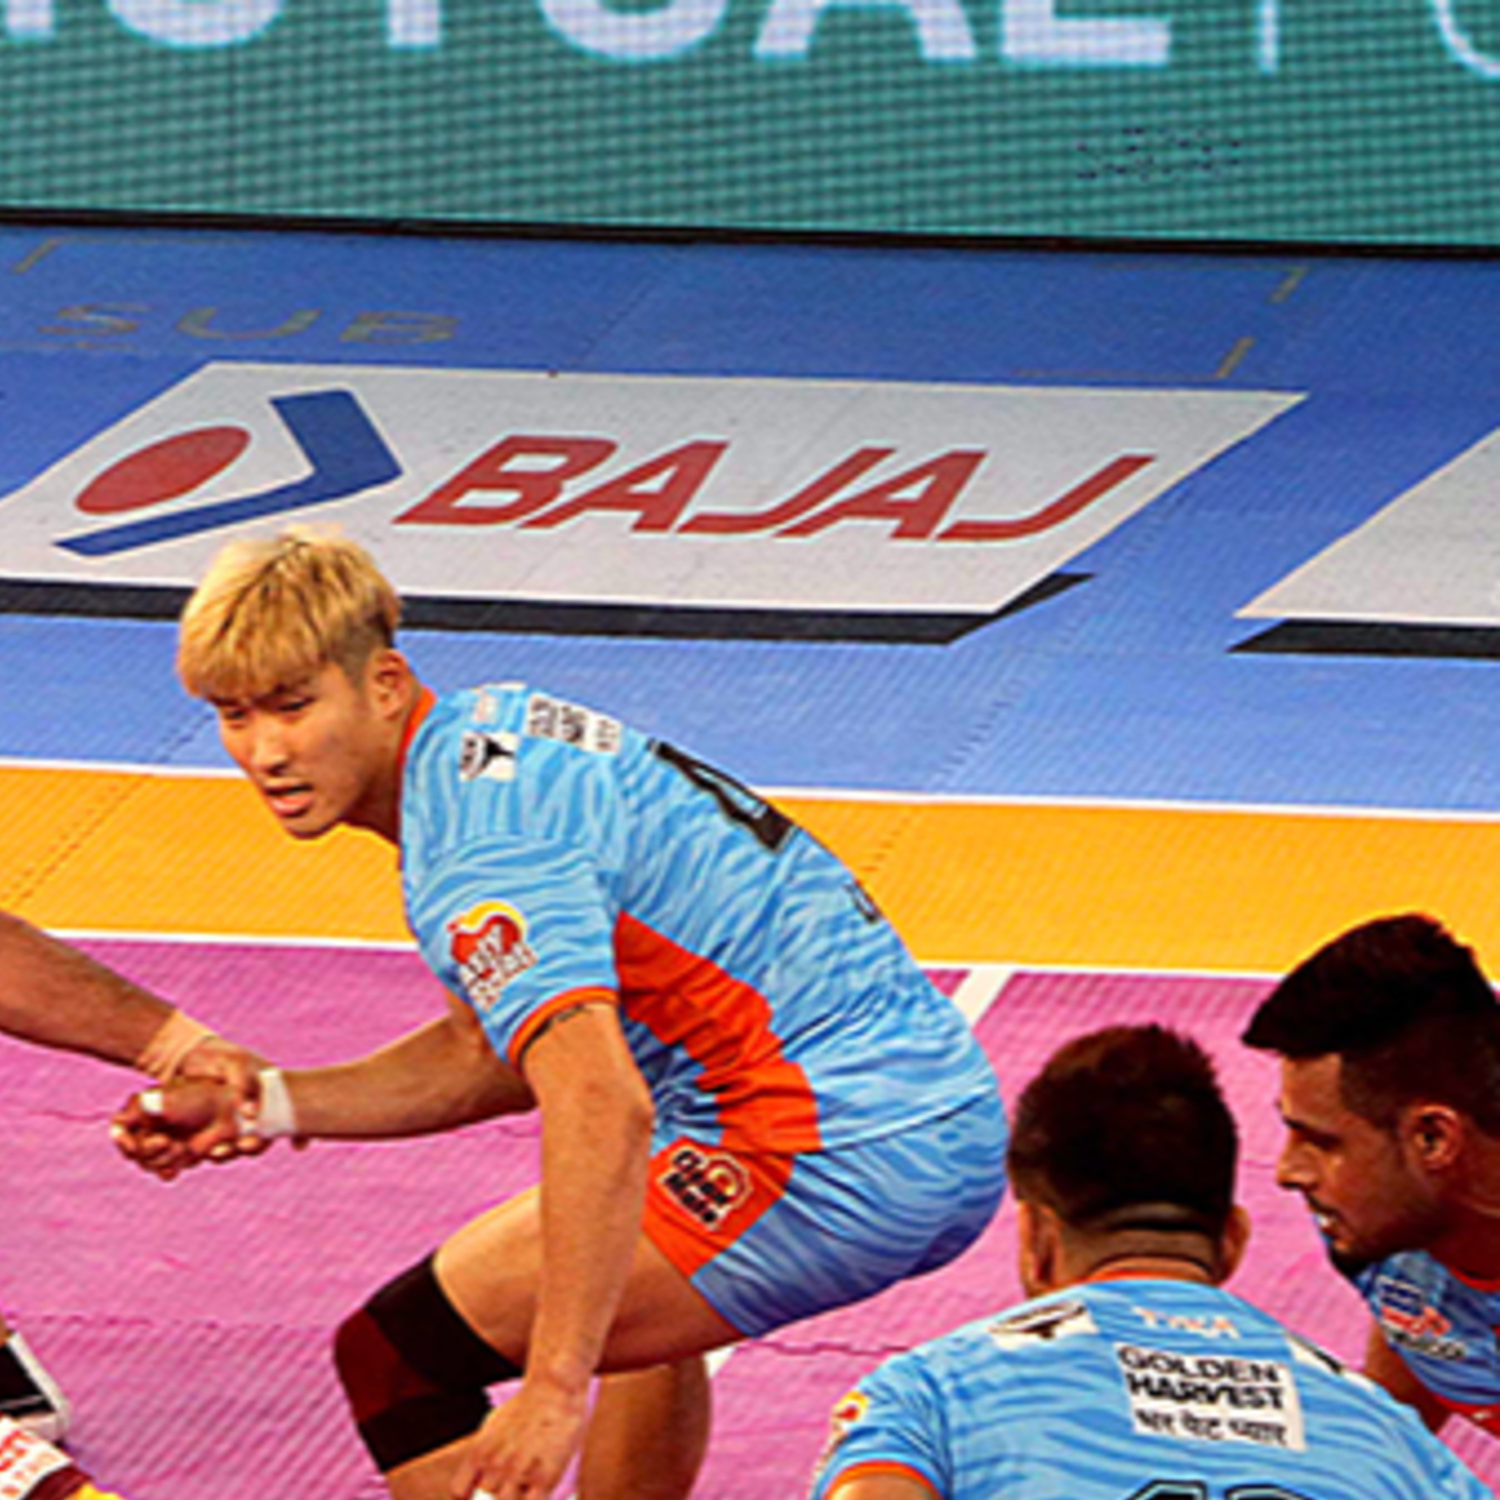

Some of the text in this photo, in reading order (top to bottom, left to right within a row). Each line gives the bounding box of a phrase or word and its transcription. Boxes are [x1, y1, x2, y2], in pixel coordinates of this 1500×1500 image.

[391, 434, 1157, 542] BAJAJ
[1118, 1345, 1280, 1384] GOLDEN
[1125, 1372, 1284, 1410] HARVEST
